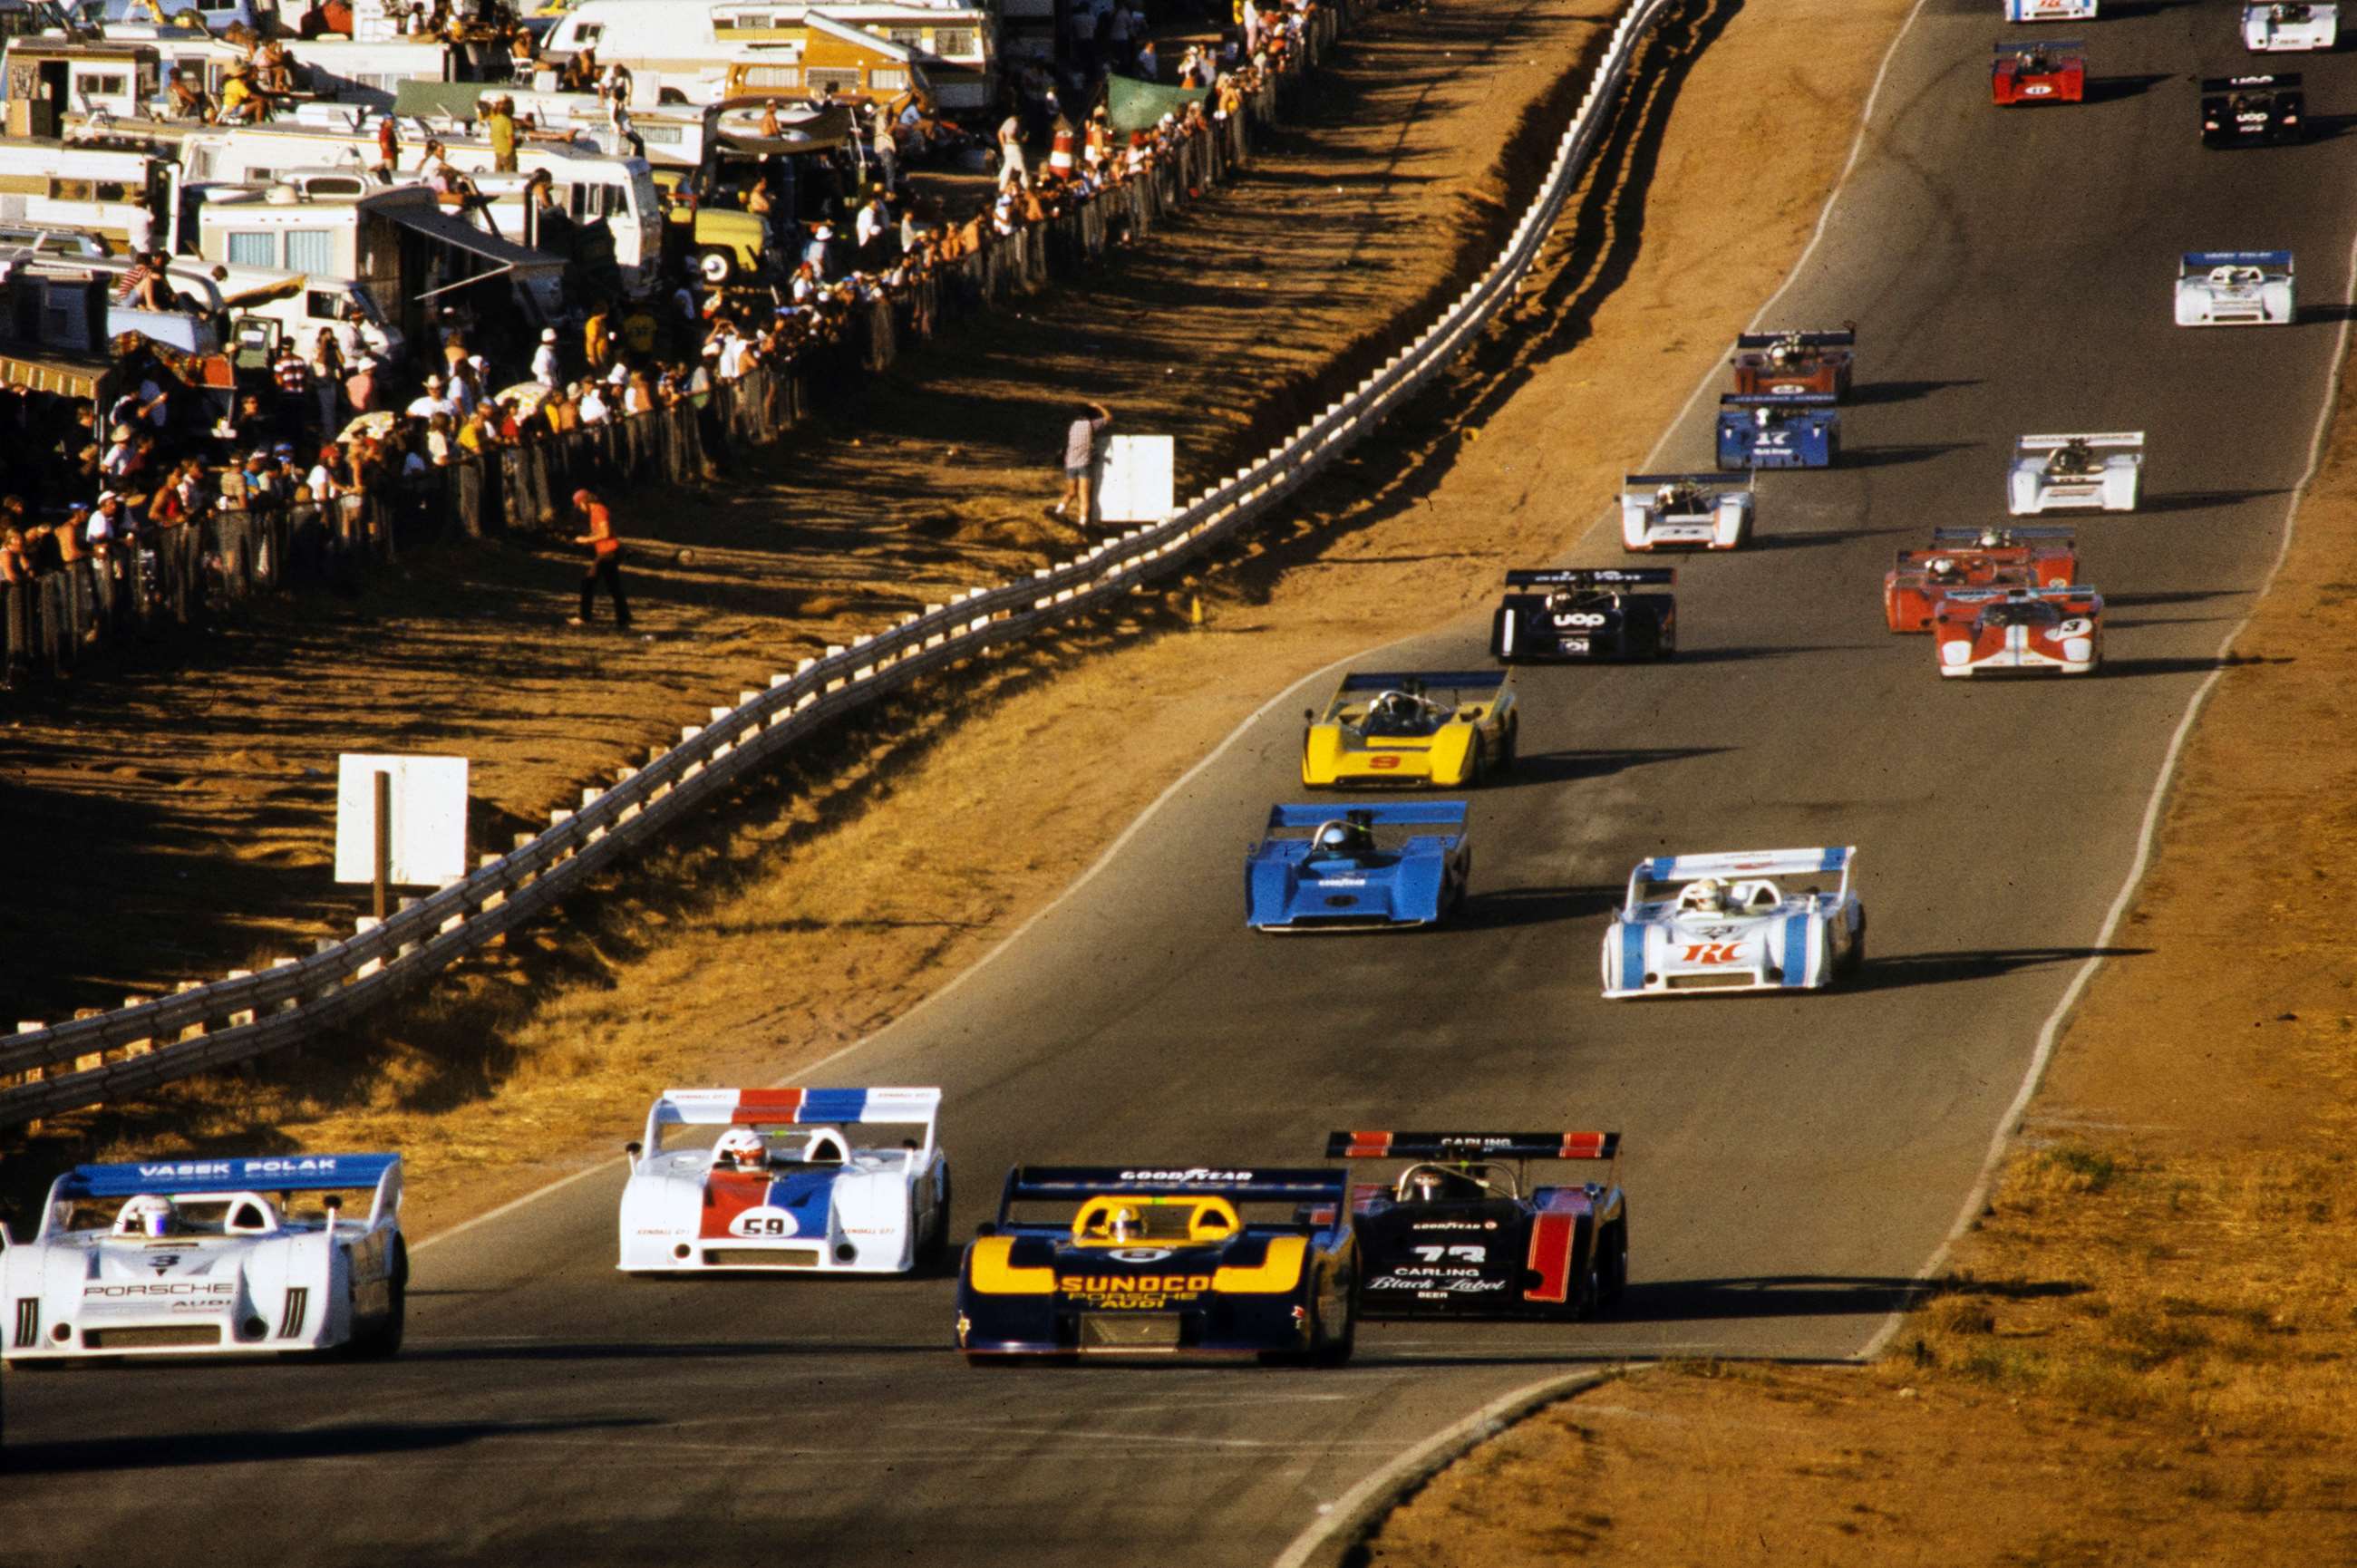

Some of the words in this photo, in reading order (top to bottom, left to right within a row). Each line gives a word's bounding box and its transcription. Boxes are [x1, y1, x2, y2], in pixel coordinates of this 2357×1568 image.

[139, 1163, 230, 1176] VASEK
[244, 1159, 336, 1173] POLAK
[742, 1218, 784, 1235] 59
[1393, 1268, 1480, 1277] CARLING
[83, 1283, 234, 1297] PORSCHE
[1061, 1275, 1210, 1292] SUNOCO
[1367, 1276, 1435, 1289] Black
[1438, 1278, 1507, 1292] Label
[1068, 1292, 1198, 1301] PORSCHE
[1417, 1291, 1449, 1299] BEER
[1101, 1300, 1166, 1309] AUDI
